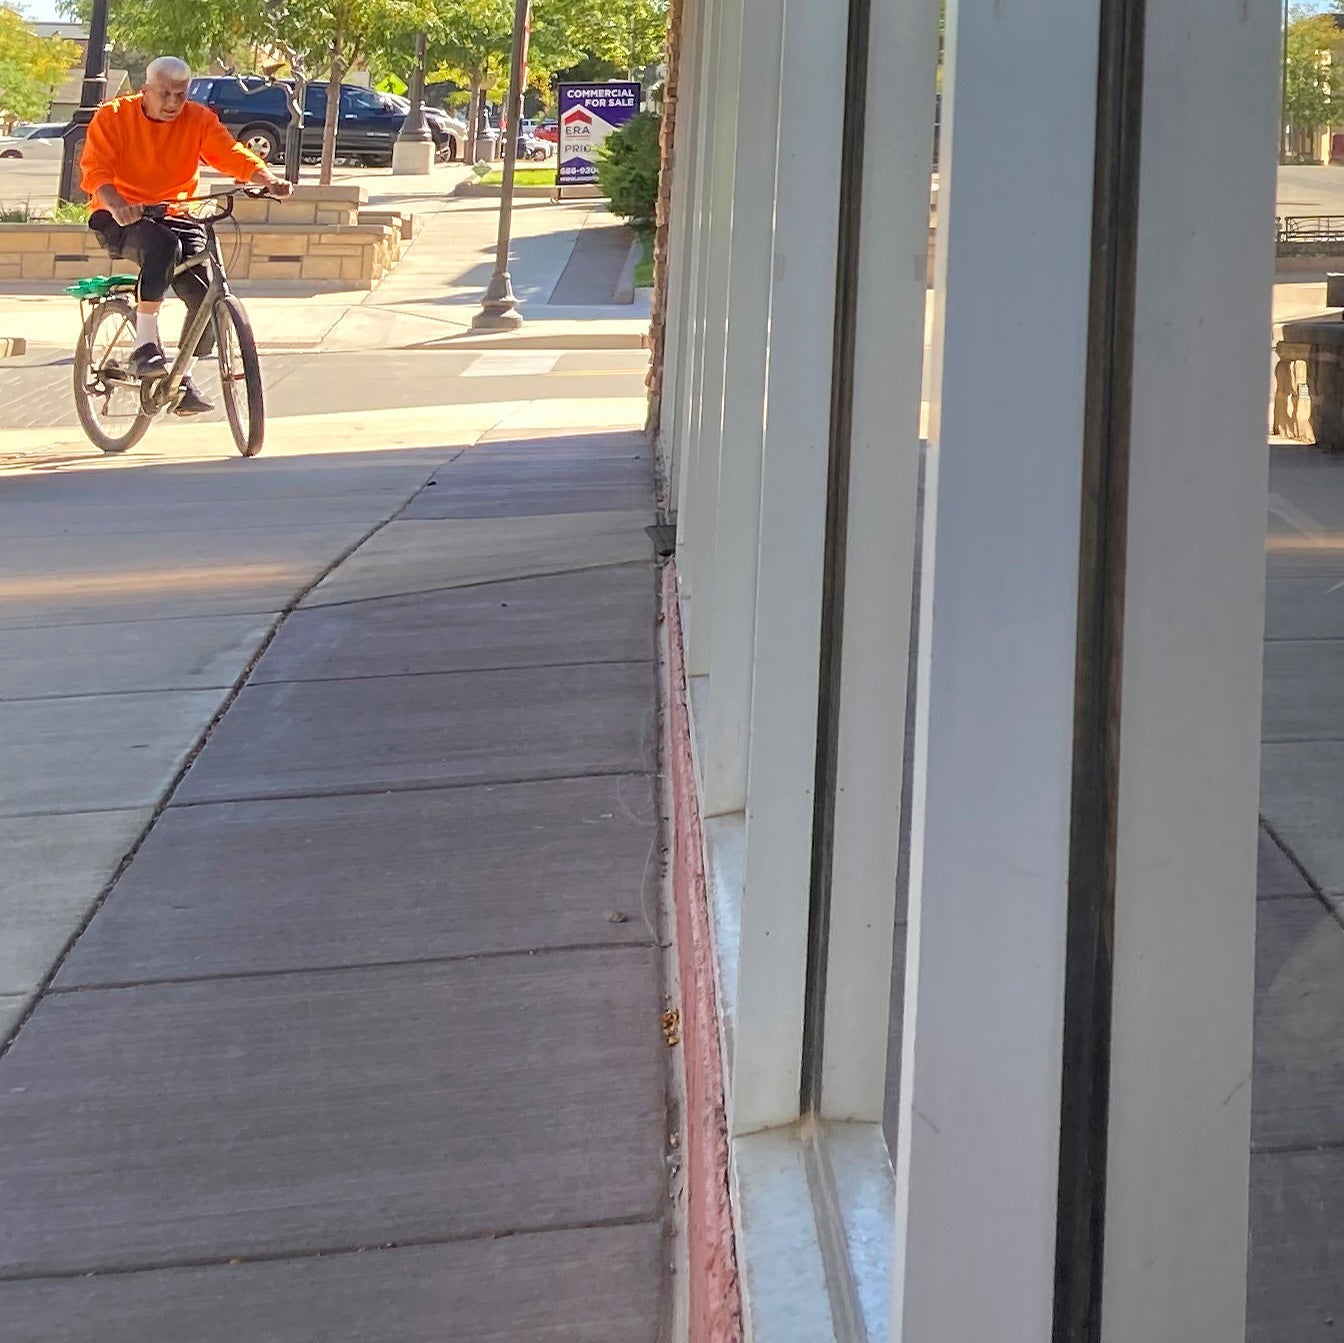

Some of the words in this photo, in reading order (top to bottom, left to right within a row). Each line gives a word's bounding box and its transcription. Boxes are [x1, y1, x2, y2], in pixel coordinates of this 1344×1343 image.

[566, 89, 635, 98] COMMERCIAL
[585, 99, 606, 108] FOR
[608, 98, 635, 107] SALE
[565, 126, 590, 135] ERA
